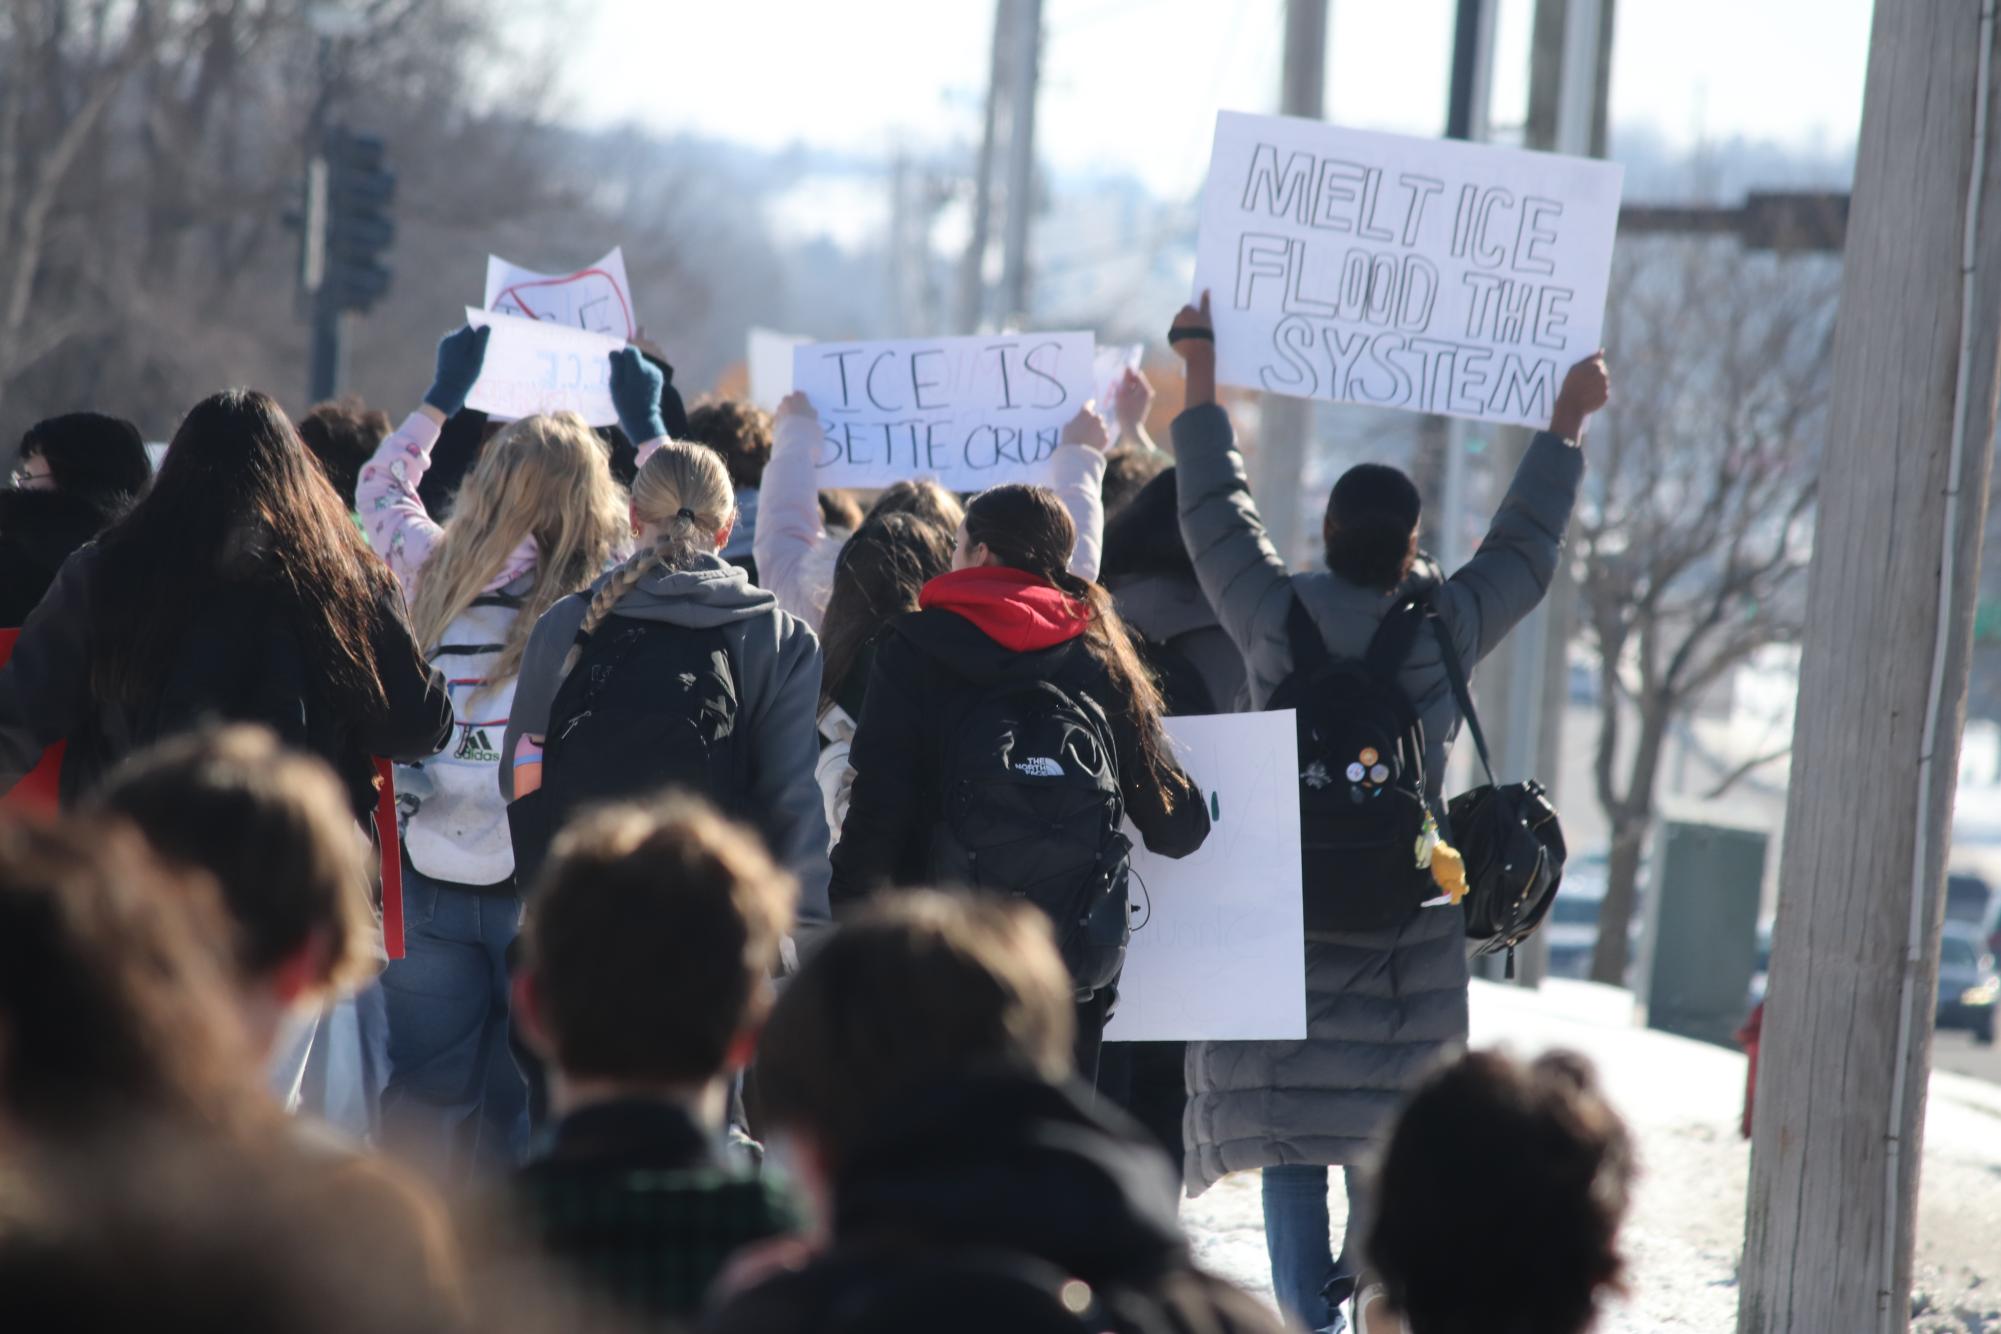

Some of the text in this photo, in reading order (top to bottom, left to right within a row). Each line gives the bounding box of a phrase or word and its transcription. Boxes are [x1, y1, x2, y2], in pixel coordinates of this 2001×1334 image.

[1241, 143, 1563, 276] MELT ICE
[1234, 232, 1574, 351] FLOOD THE
[822, 349, 950, 413] ICE
[984, 341, 1068, 412] IS
[1259, 314, 1558, 419] SYSTEM
[454, 749, 500, 761] adidas
